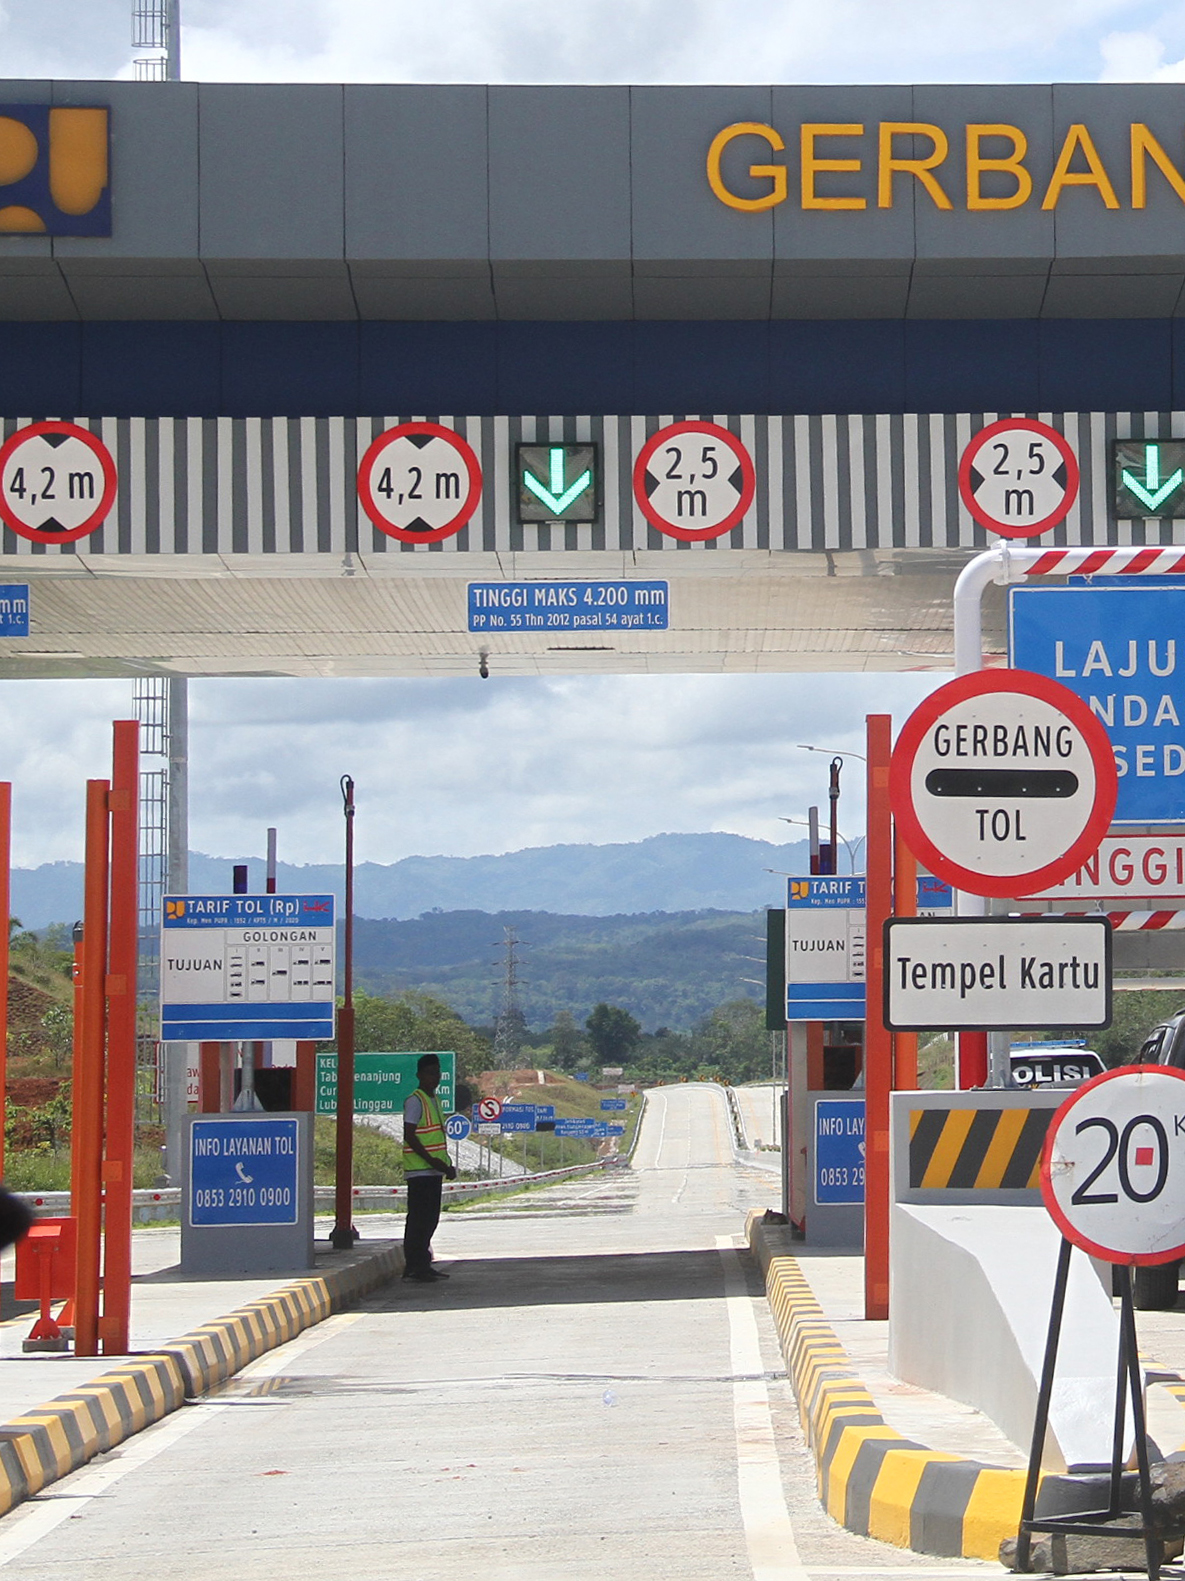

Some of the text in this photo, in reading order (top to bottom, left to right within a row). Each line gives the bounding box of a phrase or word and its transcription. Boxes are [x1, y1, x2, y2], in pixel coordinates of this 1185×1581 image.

[665, 446, 719, 485] 2,5
[992, 442, 1045, 481] 2,5
[10, 466, 95, 506] 4,2 m
[377, 466, 461, 506] 4,2 m
[677, 489, 707, 517] m
[1005, 487, 1034, 516] m
[473, 586, 665, 607] TINGGI MAKS 4.200 mm
[473, 614, 486, 627] PP
[490, 614, 507, 627] No.
[510, 613, 522, 626] 55
[525, 613, 544, 626] Thn
[547, 613, 570, 626] 2012
[573, 612, 602, 628] pasal
[605, 612, 617, 625] 54
[621, 612, 643, 628] ayat
[933, 724, 1074, 758] GERBANG
[975, 809, 1027, 842] TOL
[1059, 846, 1184, 886] NGGI
[811, 881, 851, 894] TARIF
[188, 900, 230, 914] TARIF
[236, 900, 264, 913] TOL
[270, 899, 299, 916] (Rp)
[243, 931, 317, 942] GOLONGAN
[792, 940, 845, 951] TUJUAN
[167, 959, 222, 971] TUJUAN
[897, 954, 1099, 999] Tempel Kartu
[320, 1071, 338, 1082] Tab
[354, 1070, 401, 1085] enanjung
[1011, 1064, 1091, 1084] OLISI
[320, 1086, 337, 1096] Cur
[319, 1099, 338, 1110] Lub
[446, 1121, 461, 1134] 60
[819, 1118, 844, 1135] INFO
[195, 1136, 294, 1156] INFO LAYANAN TOL
[1071, 1114, 1169, 1206] 20
[821, 1167, 865, 1186] 0853 29
[196, 1188, 290, 1207] 0853 2910 0900
